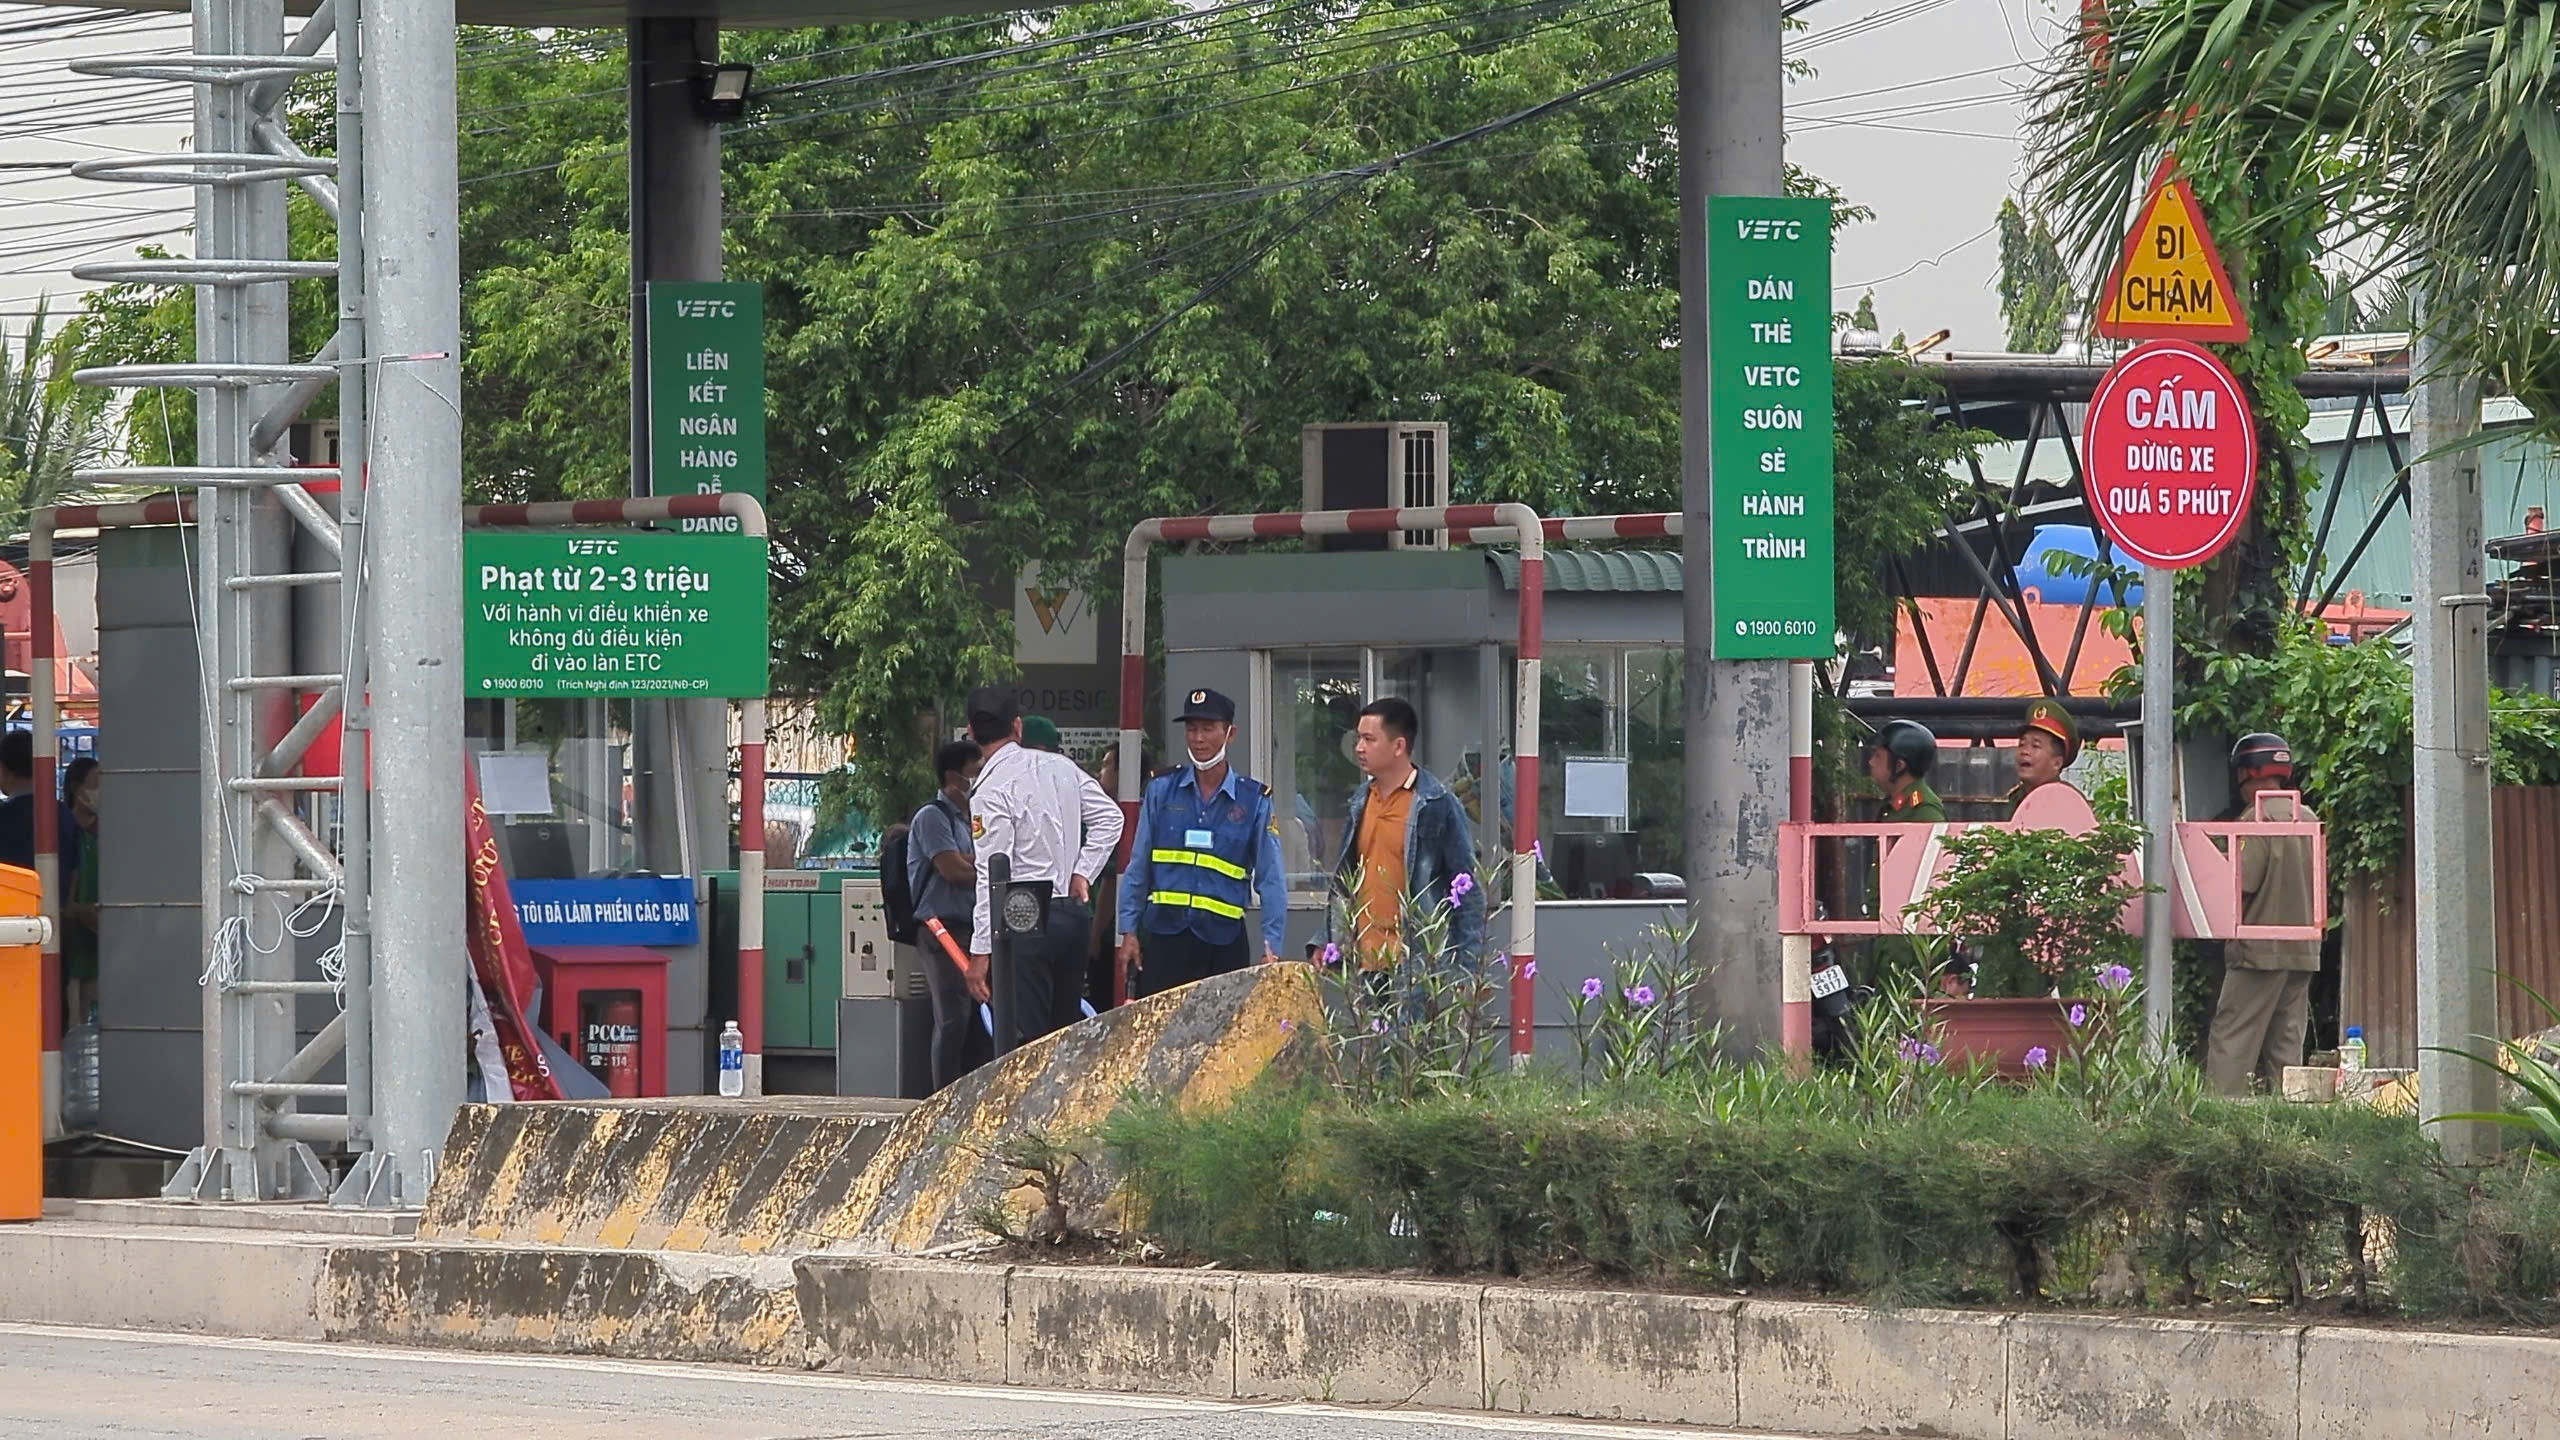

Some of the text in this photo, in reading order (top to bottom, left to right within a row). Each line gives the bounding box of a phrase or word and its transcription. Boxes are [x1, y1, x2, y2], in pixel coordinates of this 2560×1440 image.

[1738, 220, 1801, 240] VETC
[2156, 225, 2184, 259] ĐI
[1749, 275, 1792, 300] DÁN
[2127, 270, 2212, 321] CHẬM
[678, 301, 736, 317] VETC
[687, 348, 728, 370] LIÊN
[1744, 366, 1799, 386] VETC
[689, 377, 727, 402] KẾT
[2126, 375, 2216, 429] CẤM
[681, 413, 736, 435] NGÂN
[1744, 404, 1802, 429] SUÔN
[681, 446, 737, 467] HÀNG
[2127, 440, 2215, 472] DỪNG XE
[1744, 490, 1803, 515] HÀNH
[2109, 482, 2232, 516] QUÁ 5 PHÚT
[569, 540, 619, 554] VETC
[1743, 533, 1805, 558] TRÌNH
[482, 565, 708, 598] Phạt từ 2-3 triệu
[483, 600, 708, 622] Với hành vi điều khiển xe
[510, 625, 681, 650] không đủ điều kiện
[1750, 621, 1816, 635] 1900 6010
[532, 653, 660, 670] đi vào làn ETC
[494, 679, 517, 689] 1900
[520, 679, 543, 689] 6010
[522, 901, 542, 923] TÔI
[663, 903, 690, 926] BẠN
[1816, 978, 1841, 996] 5917
